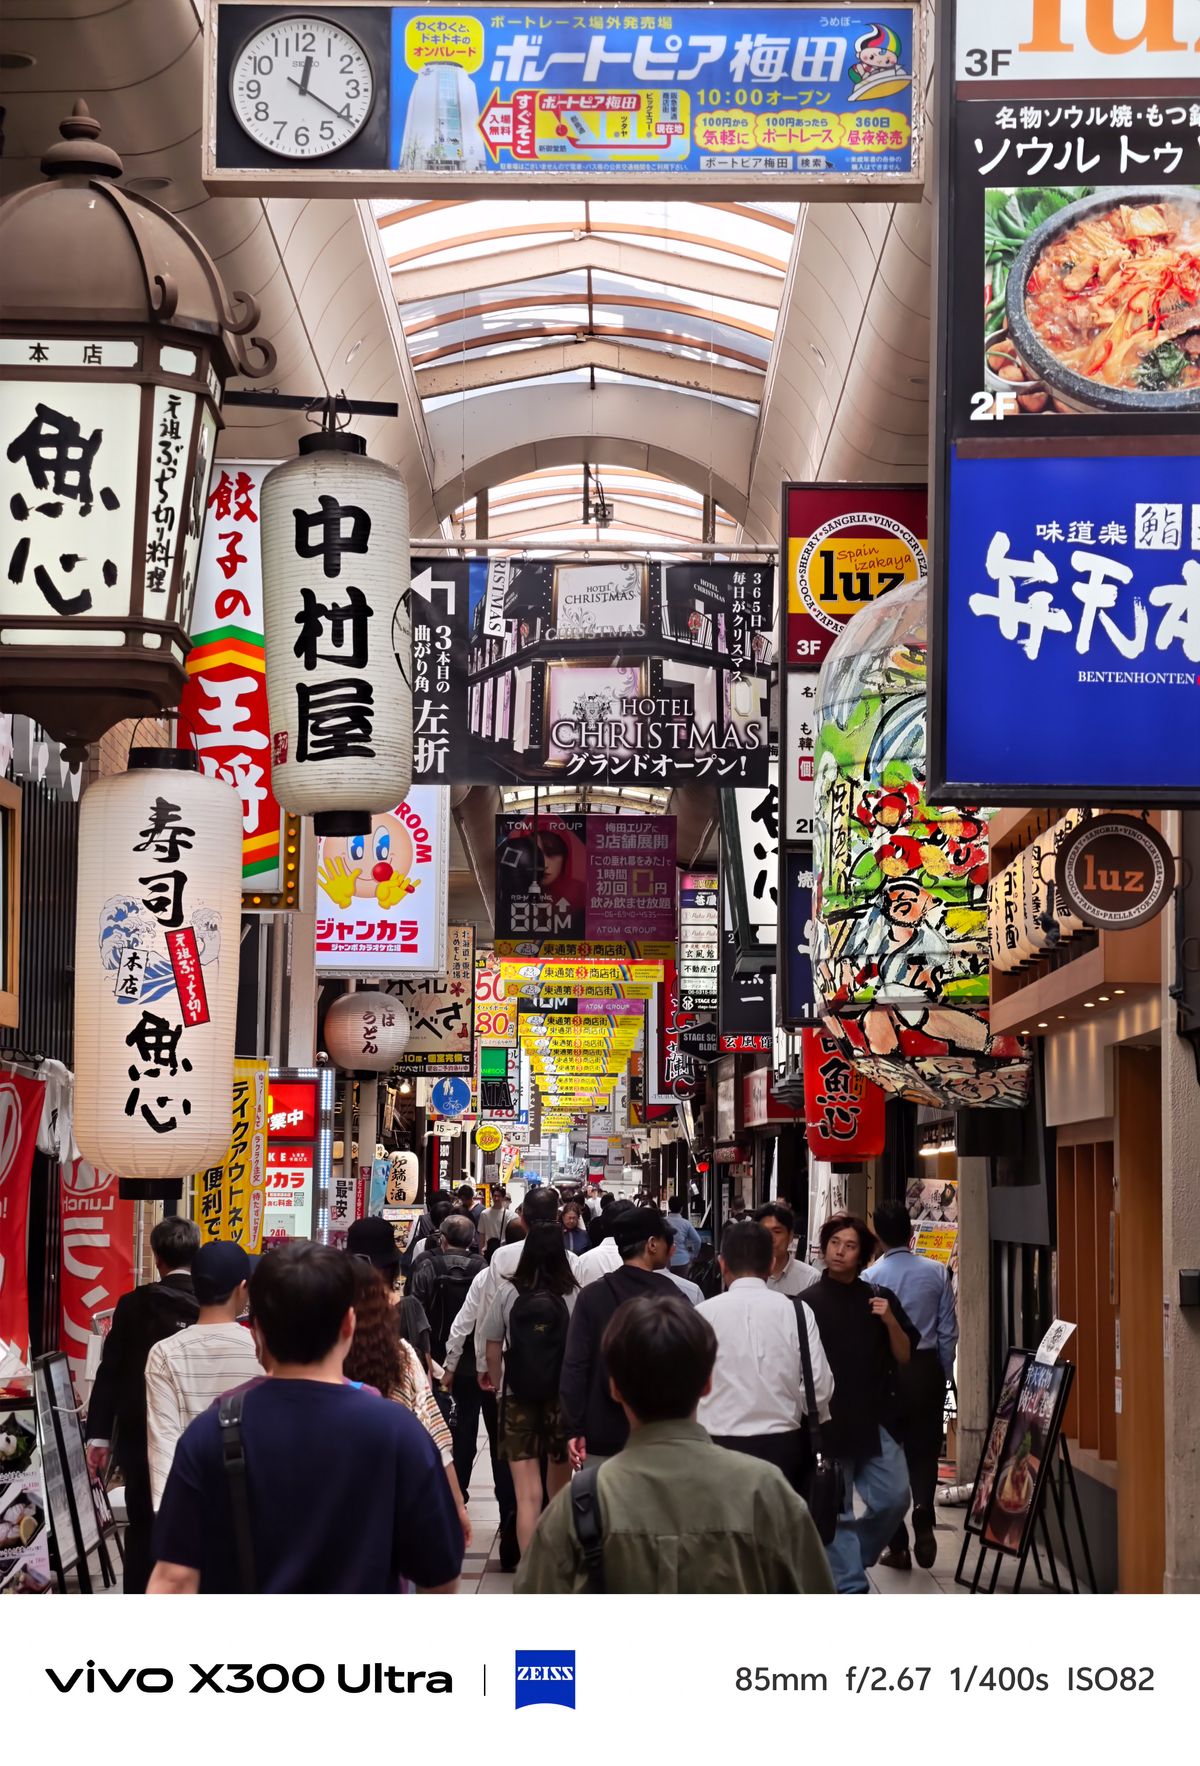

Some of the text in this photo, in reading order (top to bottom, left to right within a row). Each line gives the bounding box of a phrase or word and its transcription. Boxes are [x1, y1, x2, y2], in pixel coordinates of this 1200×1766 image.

[490, 15, 673, 30] ボートレース場外発売場
[275, 38, 289, 57] 11
[296, 33, 316, 52] 12
[327, 38, 332, 57] 1
[421, 34, 470, 45] ドキドキの
[253, 56, 273, 75] 10
[340, 55, 354, 74] 2
[489, 34, 847, 83] ボートピア梅田
[964, 48, 1012, 77] 3F
[246, 80, 261, 98] 9
[345, 79, 360, 98] 3
[254, 102, 269, 121] 8
[541, 95, 637, 109] ボートピア梅田
[489, 113, 511, 124] 入場
[515, 94, 532, 154] すぐそこ
[702, 117, 748, 128] 100円から
[765, 117, 828, 128] 100円あったら
[855, 117, 890, 128] 360日
[273, 121, 288, 140] 7
[295, 127, 310, 146] 6
[319, 121, 334, 139] 5
[489, 126, 511, 136] 無料
[656, 123, 684, 134] 現在地
[702, 129, 750, 145] 気軽に
[762, 128, 834, 143] ボートレース
[847, 130, 903, 145] 昼夜発売
[705, 157, 788, 169] ボートピア梅田
[801, 158, 822, 169] 検索
[973, 136, 1101, 176] ソウル
[970, 391, 1017, 421] 2F
[7, 402, 121, 616] 魚心
[822, 514, 868, 535] SANGRIA
[873, 515, 901, 532] VINO
[1036, 520, 1128, 545] 味道楽
[208, 470, 258, 620] 餃子の
[798, 533, 820, 574] SHERRY
[836, 543, 880, 563] Spain
[854, 554, 912, 570] izakaya
[819, 550, 905, 602] luz
[565, 590, 635, 605] CHRISTMAS
[586, 584, 612, 592] HOTEL
[799, 578, 813, 609] COCA
[751, 572, 763, 628] 365日
[292, 494, 376, 763] 中村屋
[730, 571, 746, 683] 毎日がクリスマス
[797, 640, 822, 656] 3F
[414, 624, 431, 693] 曲がり角
[435, 625, 452, 693] 3本目の
[1077, 670, 1196, 685] BENTENHONTEN
[622, 699, 694, 717] HOTEL
[413, 700, 450, 774] 左折
[551, 721, 761, 750] CHRISTMAS
[190, 676, 268, 834] 王将
[566, 753, 747, 777] グランドオープン!
[394, 801, 433, 864] ROOM
[605, 823, 658, 833] 梅田エリアに
[1123, 827, 1142, 841] VINO
[596, 834, 669, 849] 3店舗展開
[131, 796, 196, 929] 寿司
[597, 869, 628, 880] 1時間
[1083, 854, 1145, 892] luz
[596, 882, 627, 895] 初回
[591, 898, 671, 909] 飲み飲ませ放題
[316, 917, 419, 942] ジャンカラ
[118, 951, 143, 997] 本店
[545, 966, 619, 979] 東通第3商店街
[361, 1010, 379, 1054] うどん
[684, 1033, 703, 1042] STAGE
[124, 1010, 194, 1135] 魚心
[816, 1056, 862, 1140] 魚心
[268, 1109, 304, 1131] 業中
